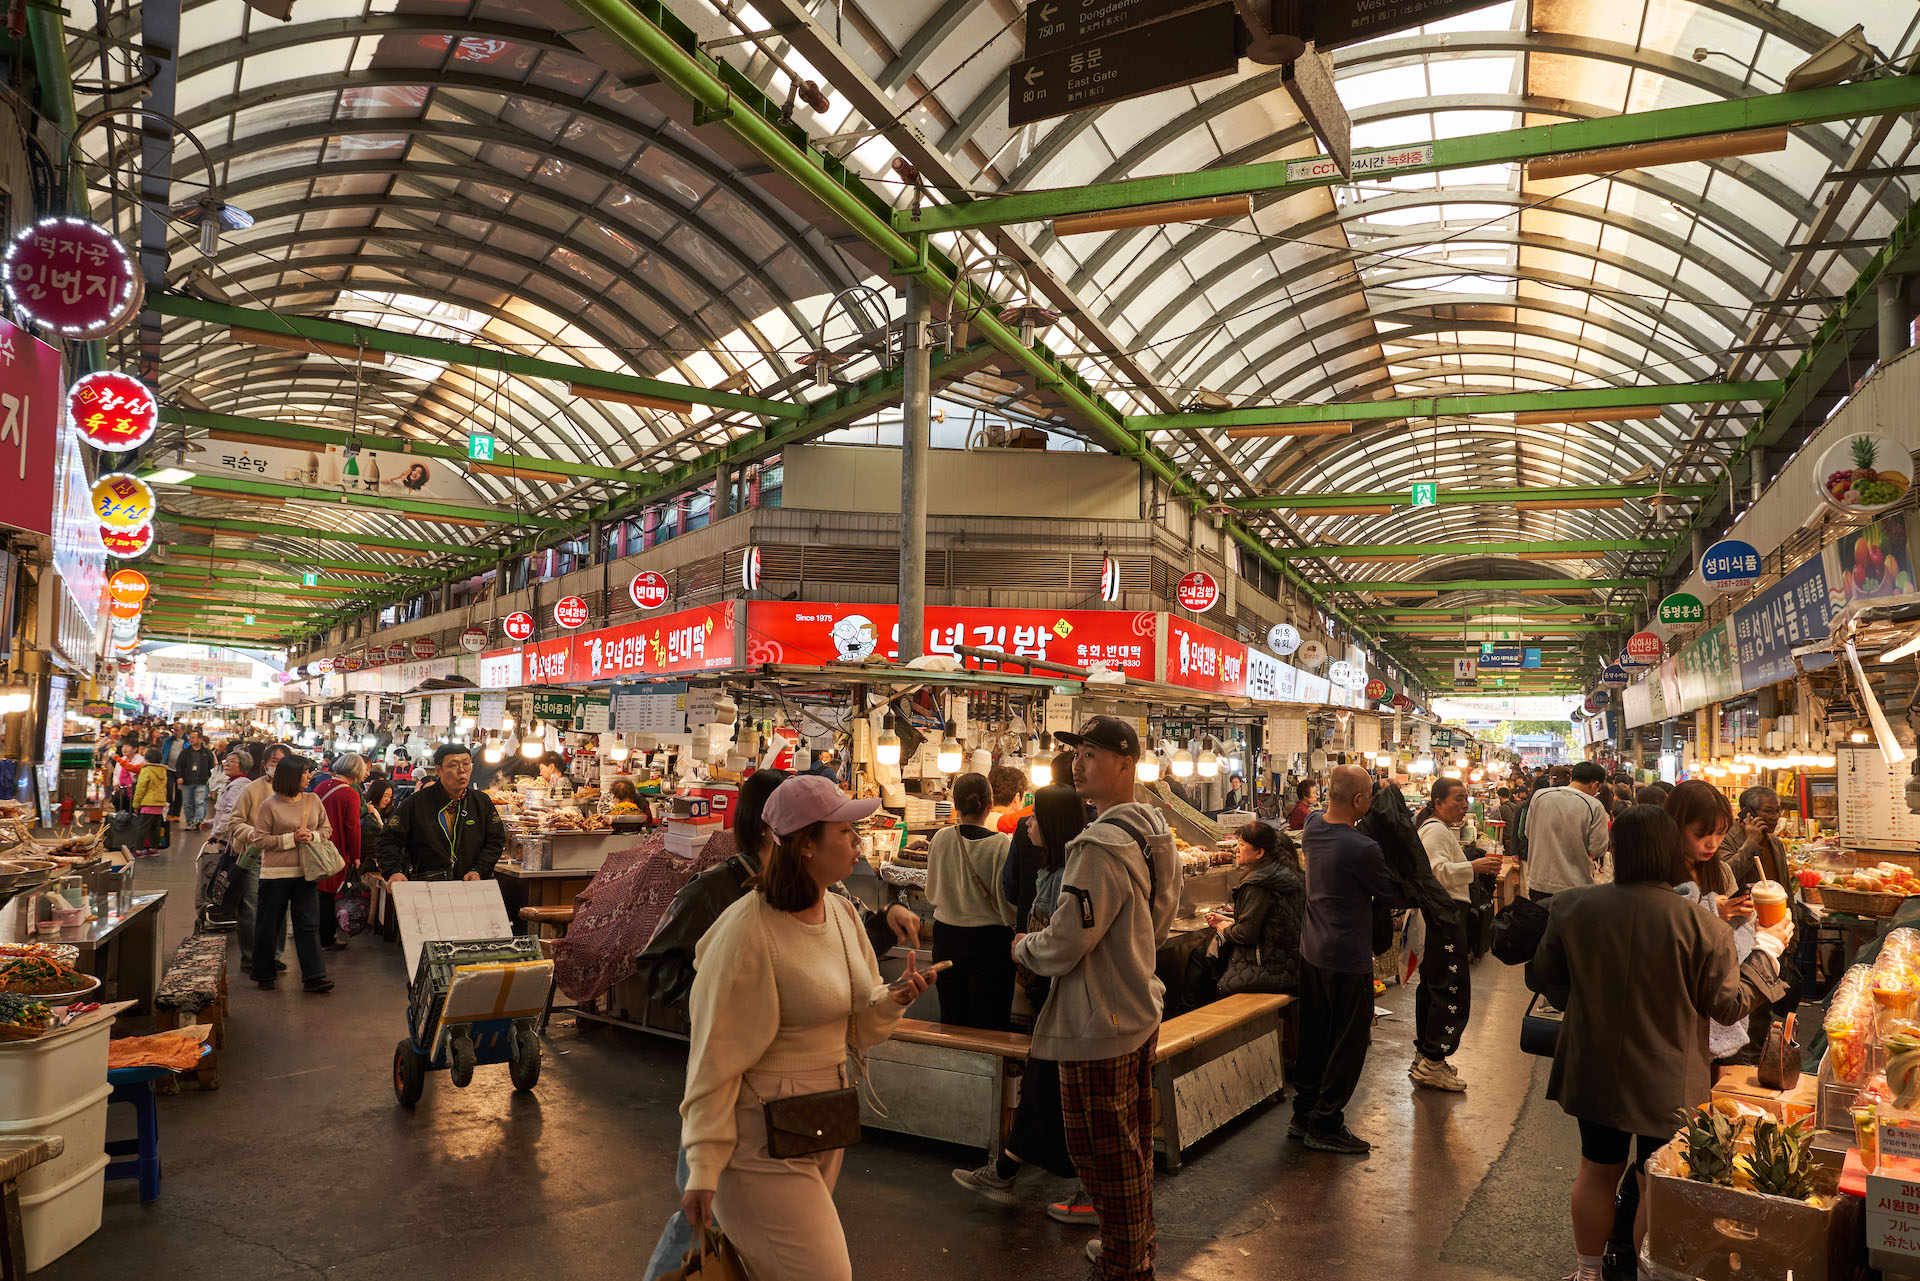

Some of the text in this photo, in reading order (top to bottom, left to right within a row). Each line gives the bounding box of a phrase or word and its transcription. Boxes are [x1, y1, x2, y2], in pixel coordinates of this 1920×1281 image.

[1356, 0, 1386, 13] West
[1038, 22, 1065, 39] 750 m
[1068, 48, 1103, 74] 동문
[1067, 68, 1118, 90] East Gate
[1023, 89, 1047, 103] 80 m
[1351, 156, 1385, 170] 24시간
[1387, 151, 1423, 166] 녹화중
[16, 263, 117, 311] 일번지
[85, 413, 137, 434] 육회
[221, 455, 269, 473] 국순당
[1705, 554, 1758, 575] 성미식품
[636, 585, 665, 600] 빈대떡
[1179, 586, 1215, 598] 모녀김밥
[795, 613, 833, 622] Since 1975
[1661, 604, 1702, 619] 동명홍삼
[509, 623, 530, 635] 육회
[1751, 590, 1800, 657] 성미식품
[603, 634, 647, 670] 모녀김밥
[668, 623, 705, 663] 빈대떡
[887, 622, 1054, 664] 녀김밥
[1630, 638, 1660, 653] 신안상회
[538, 650, 566, 678] 모녀김밥
[1190, 642, 1217, 677] 모녀김밥
[533, 702, 572, 715] 순대아줌마
[1878, 1197, 1920, 1215] 시원한
